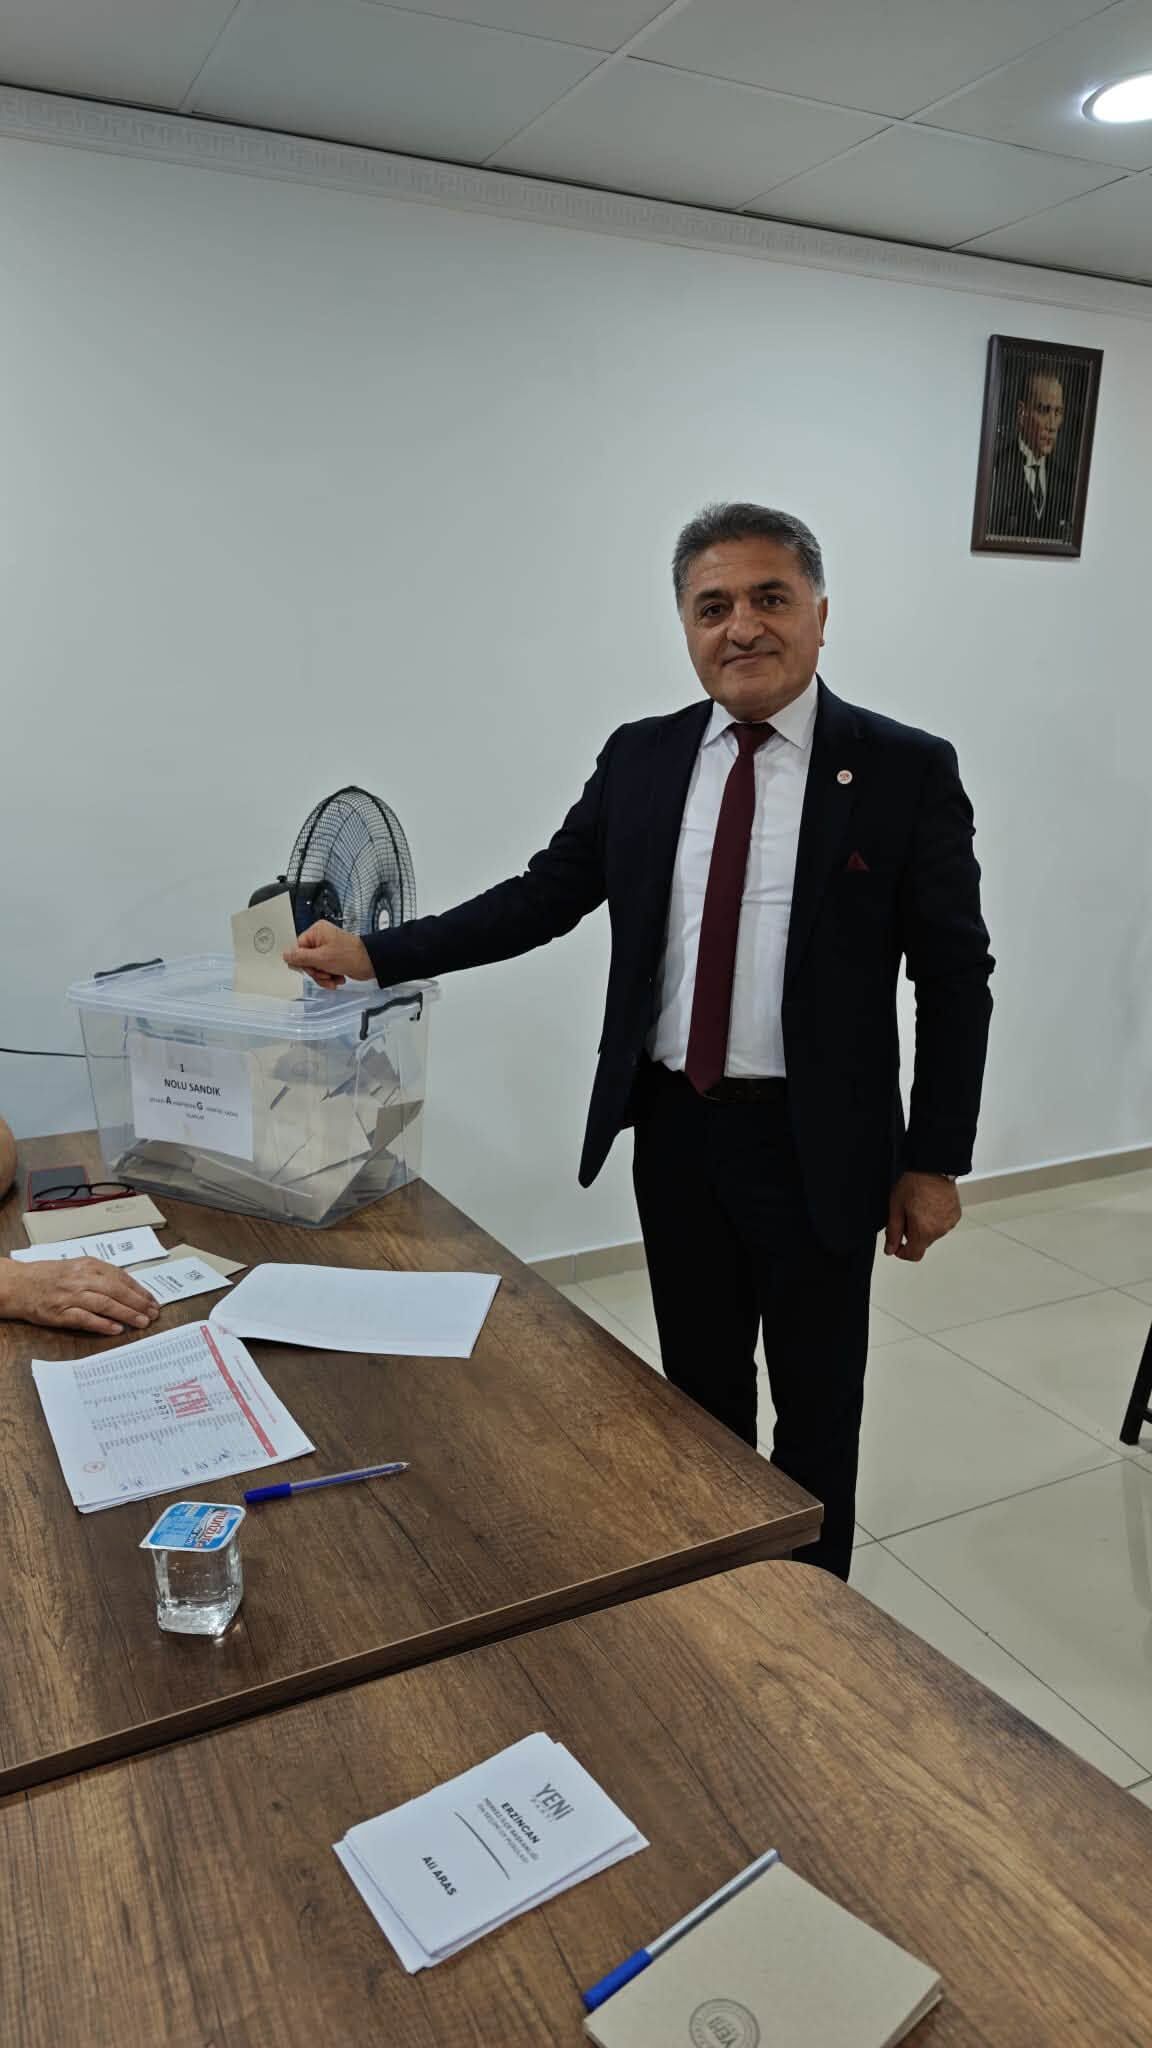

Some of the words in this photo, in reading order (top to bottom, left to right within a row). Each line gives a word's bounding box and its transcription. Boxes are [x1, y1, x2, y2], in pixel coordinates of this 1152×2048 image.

[180, 1063, 185, 1073] 1
[164, 1078, 187, 1090] NOLU
[189, 1083, 221, 1096] SANDIK
[196, 1102, 203, 1111] G
[501, 1801, 541, 1844] ERZİNCAN
[433, 1869, 457, 1896] ARAS
